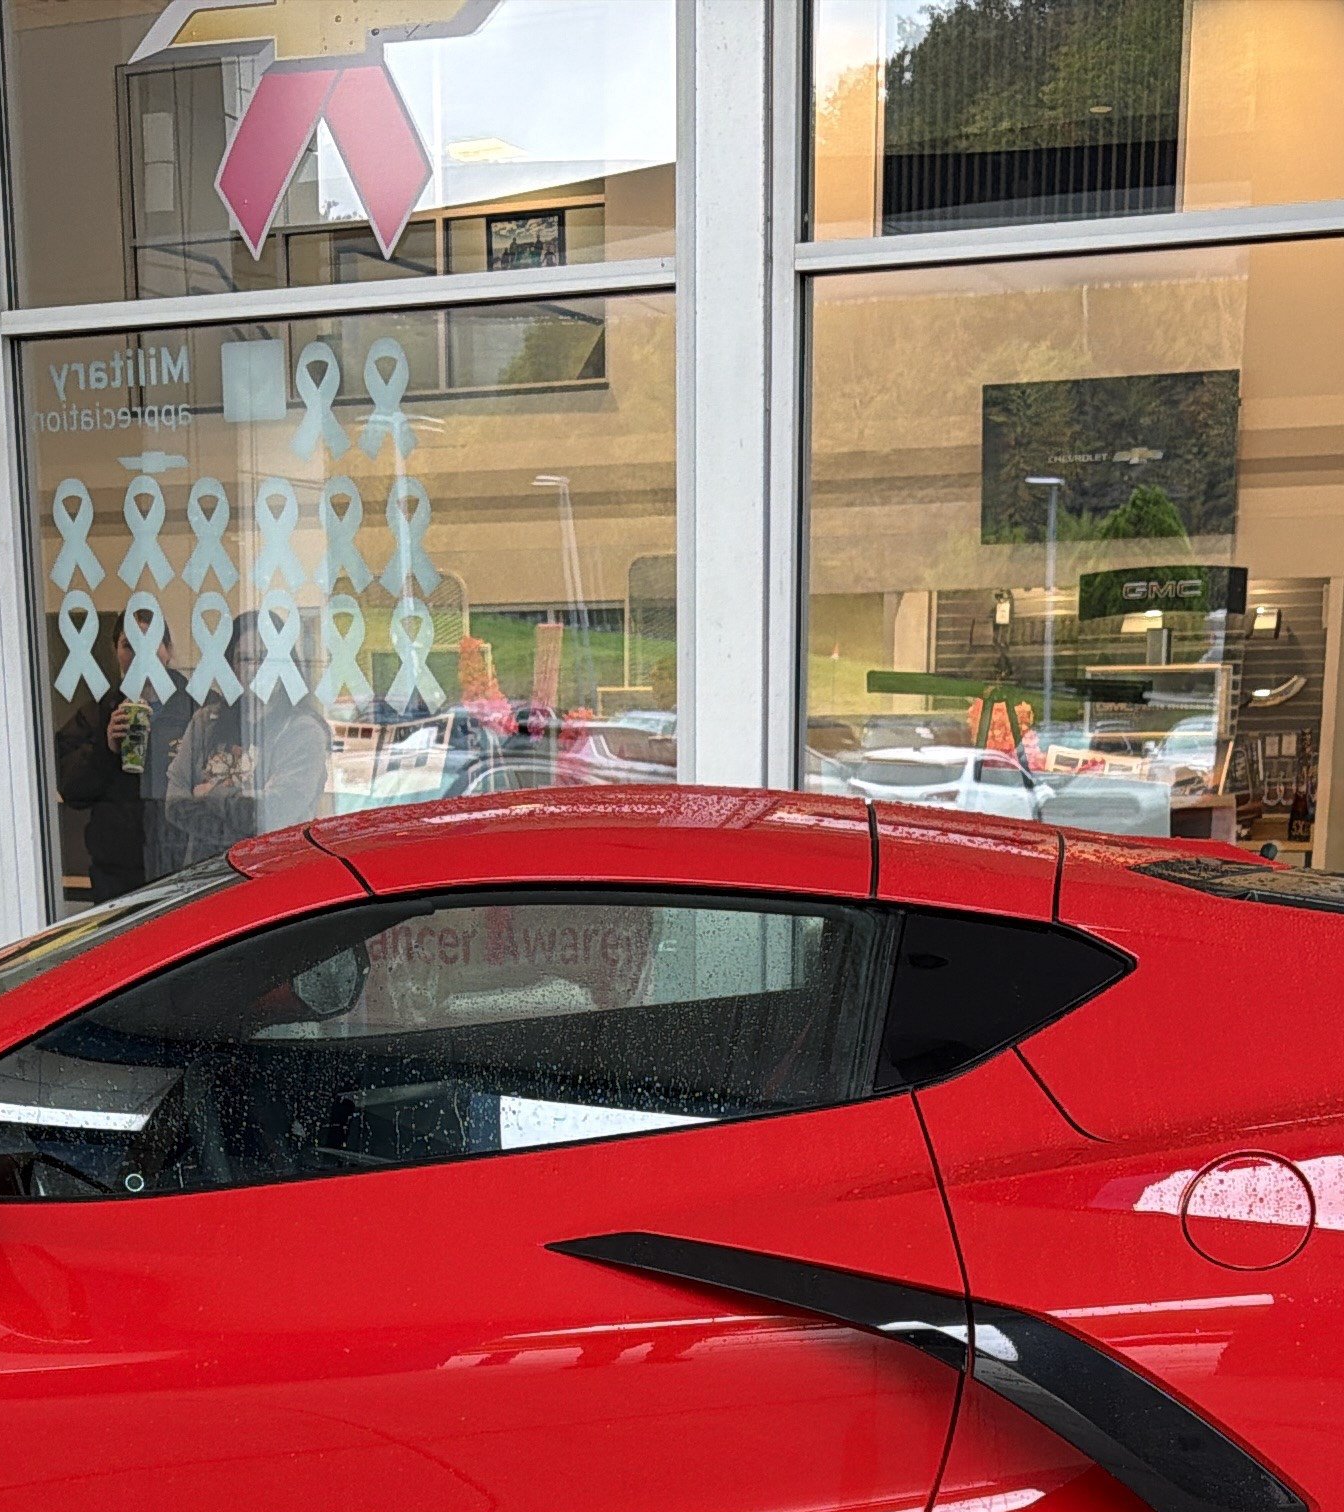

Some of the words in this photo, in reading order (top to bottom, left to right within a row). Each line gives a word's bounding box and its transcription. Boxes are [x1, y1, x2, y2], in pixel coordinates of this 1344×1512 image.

[1122, 579, 1202, 599] GMC
[369, 925, 477, 965] ancer
[489, 917, 640, 970] Aware
